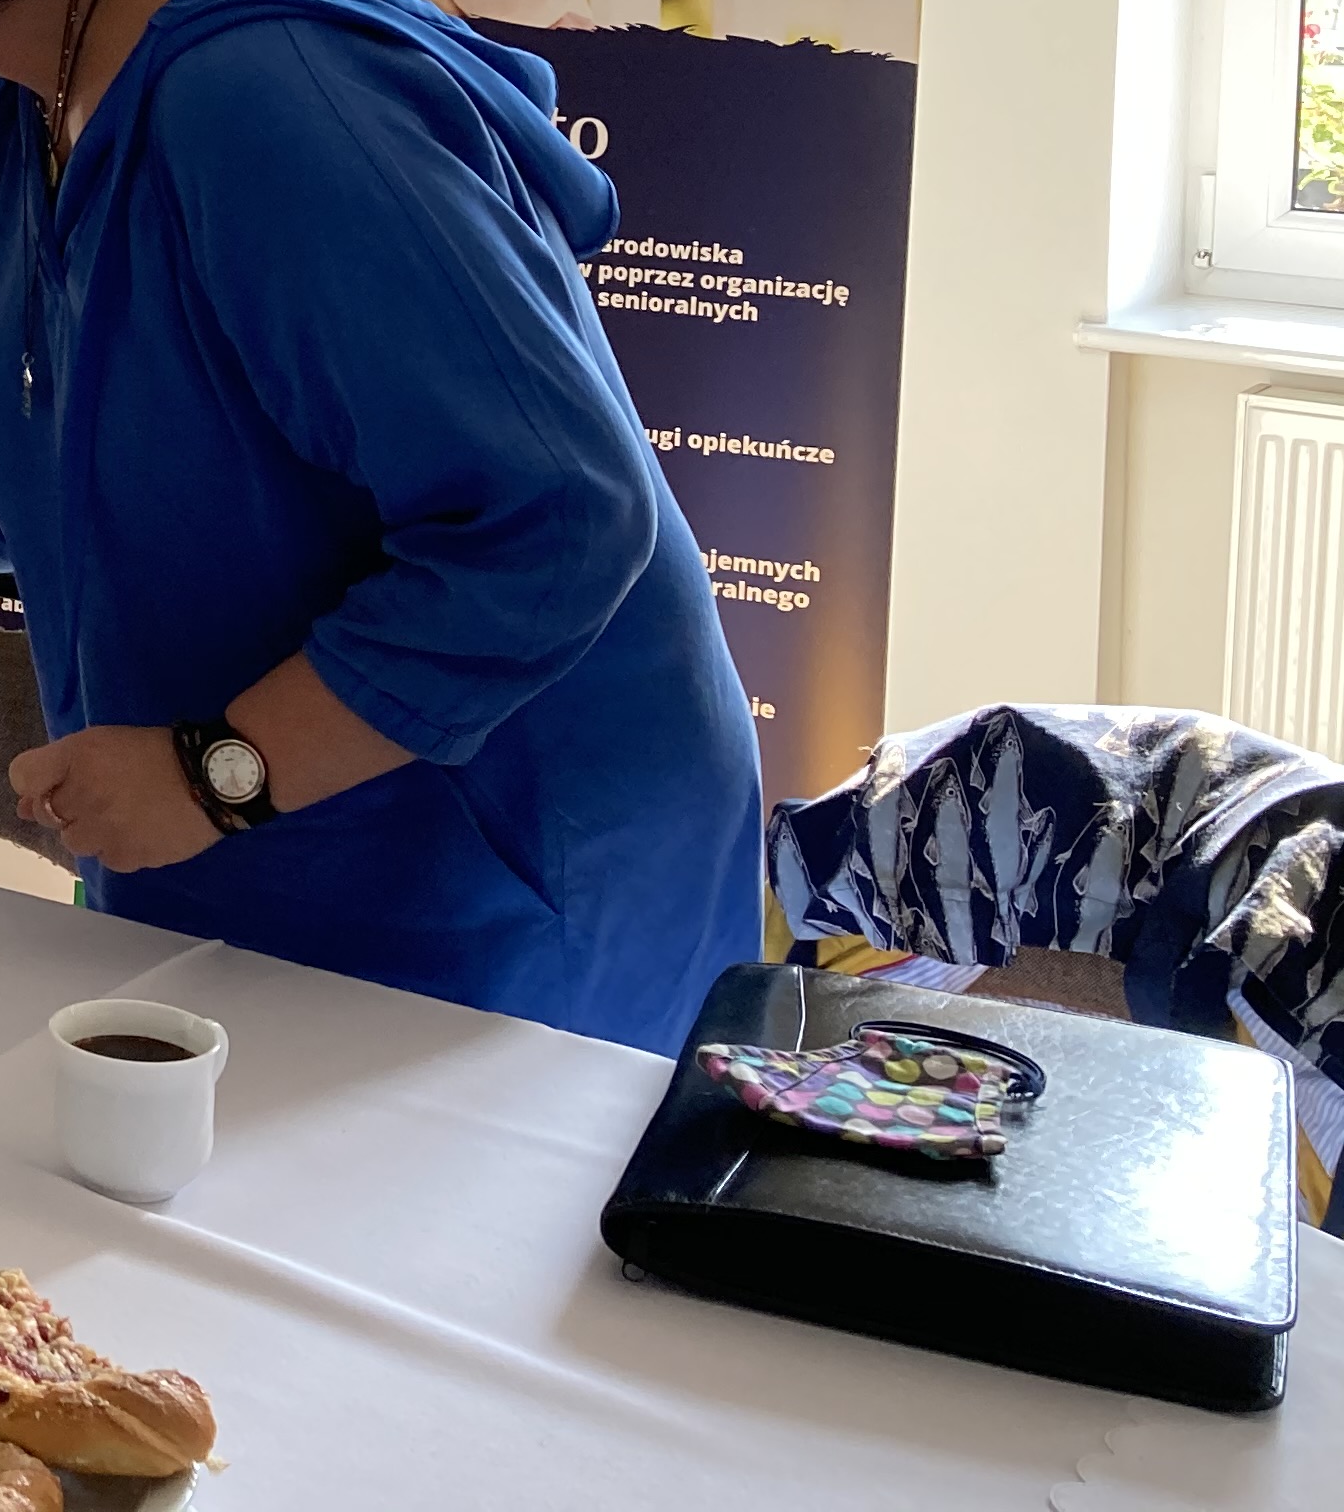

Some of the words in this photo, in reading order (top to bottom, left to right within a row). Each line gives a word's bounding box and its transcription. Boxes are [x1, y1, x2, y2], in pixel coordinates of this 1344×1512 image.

[597, 262, 694, 287] poprzez
[700, 275, 850, 307] organizację
[597, 290, 759, 323] senioralnych
[687, 431, 835, 464] opiekuńcze
[712, 580, 810, 612] ralnego
